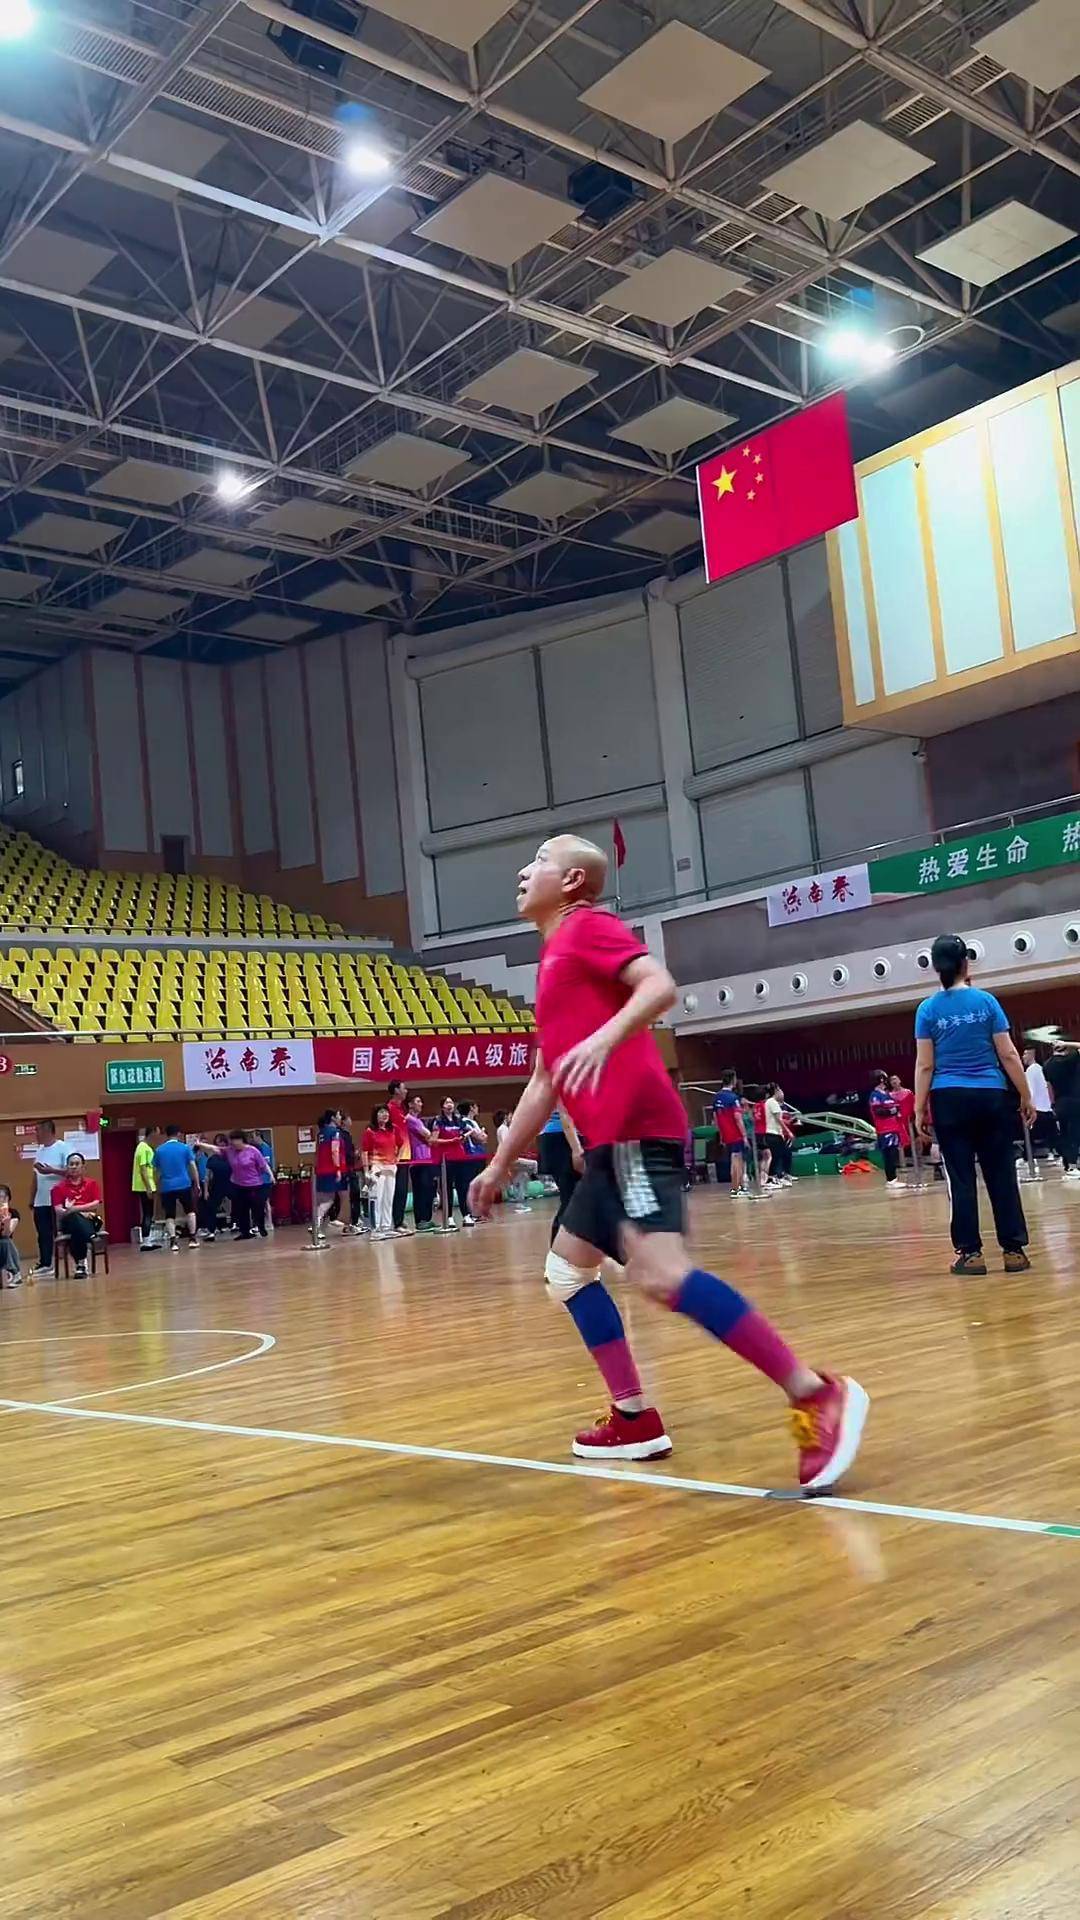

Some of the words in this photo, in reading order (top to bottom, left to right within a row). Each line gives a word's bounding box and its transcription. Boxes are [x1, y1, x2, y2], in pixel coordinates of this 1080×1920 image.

[918, 834, 1030, 885] 热爱生命
[352, 1042, 529, 1073] 国家AAAA级旅
